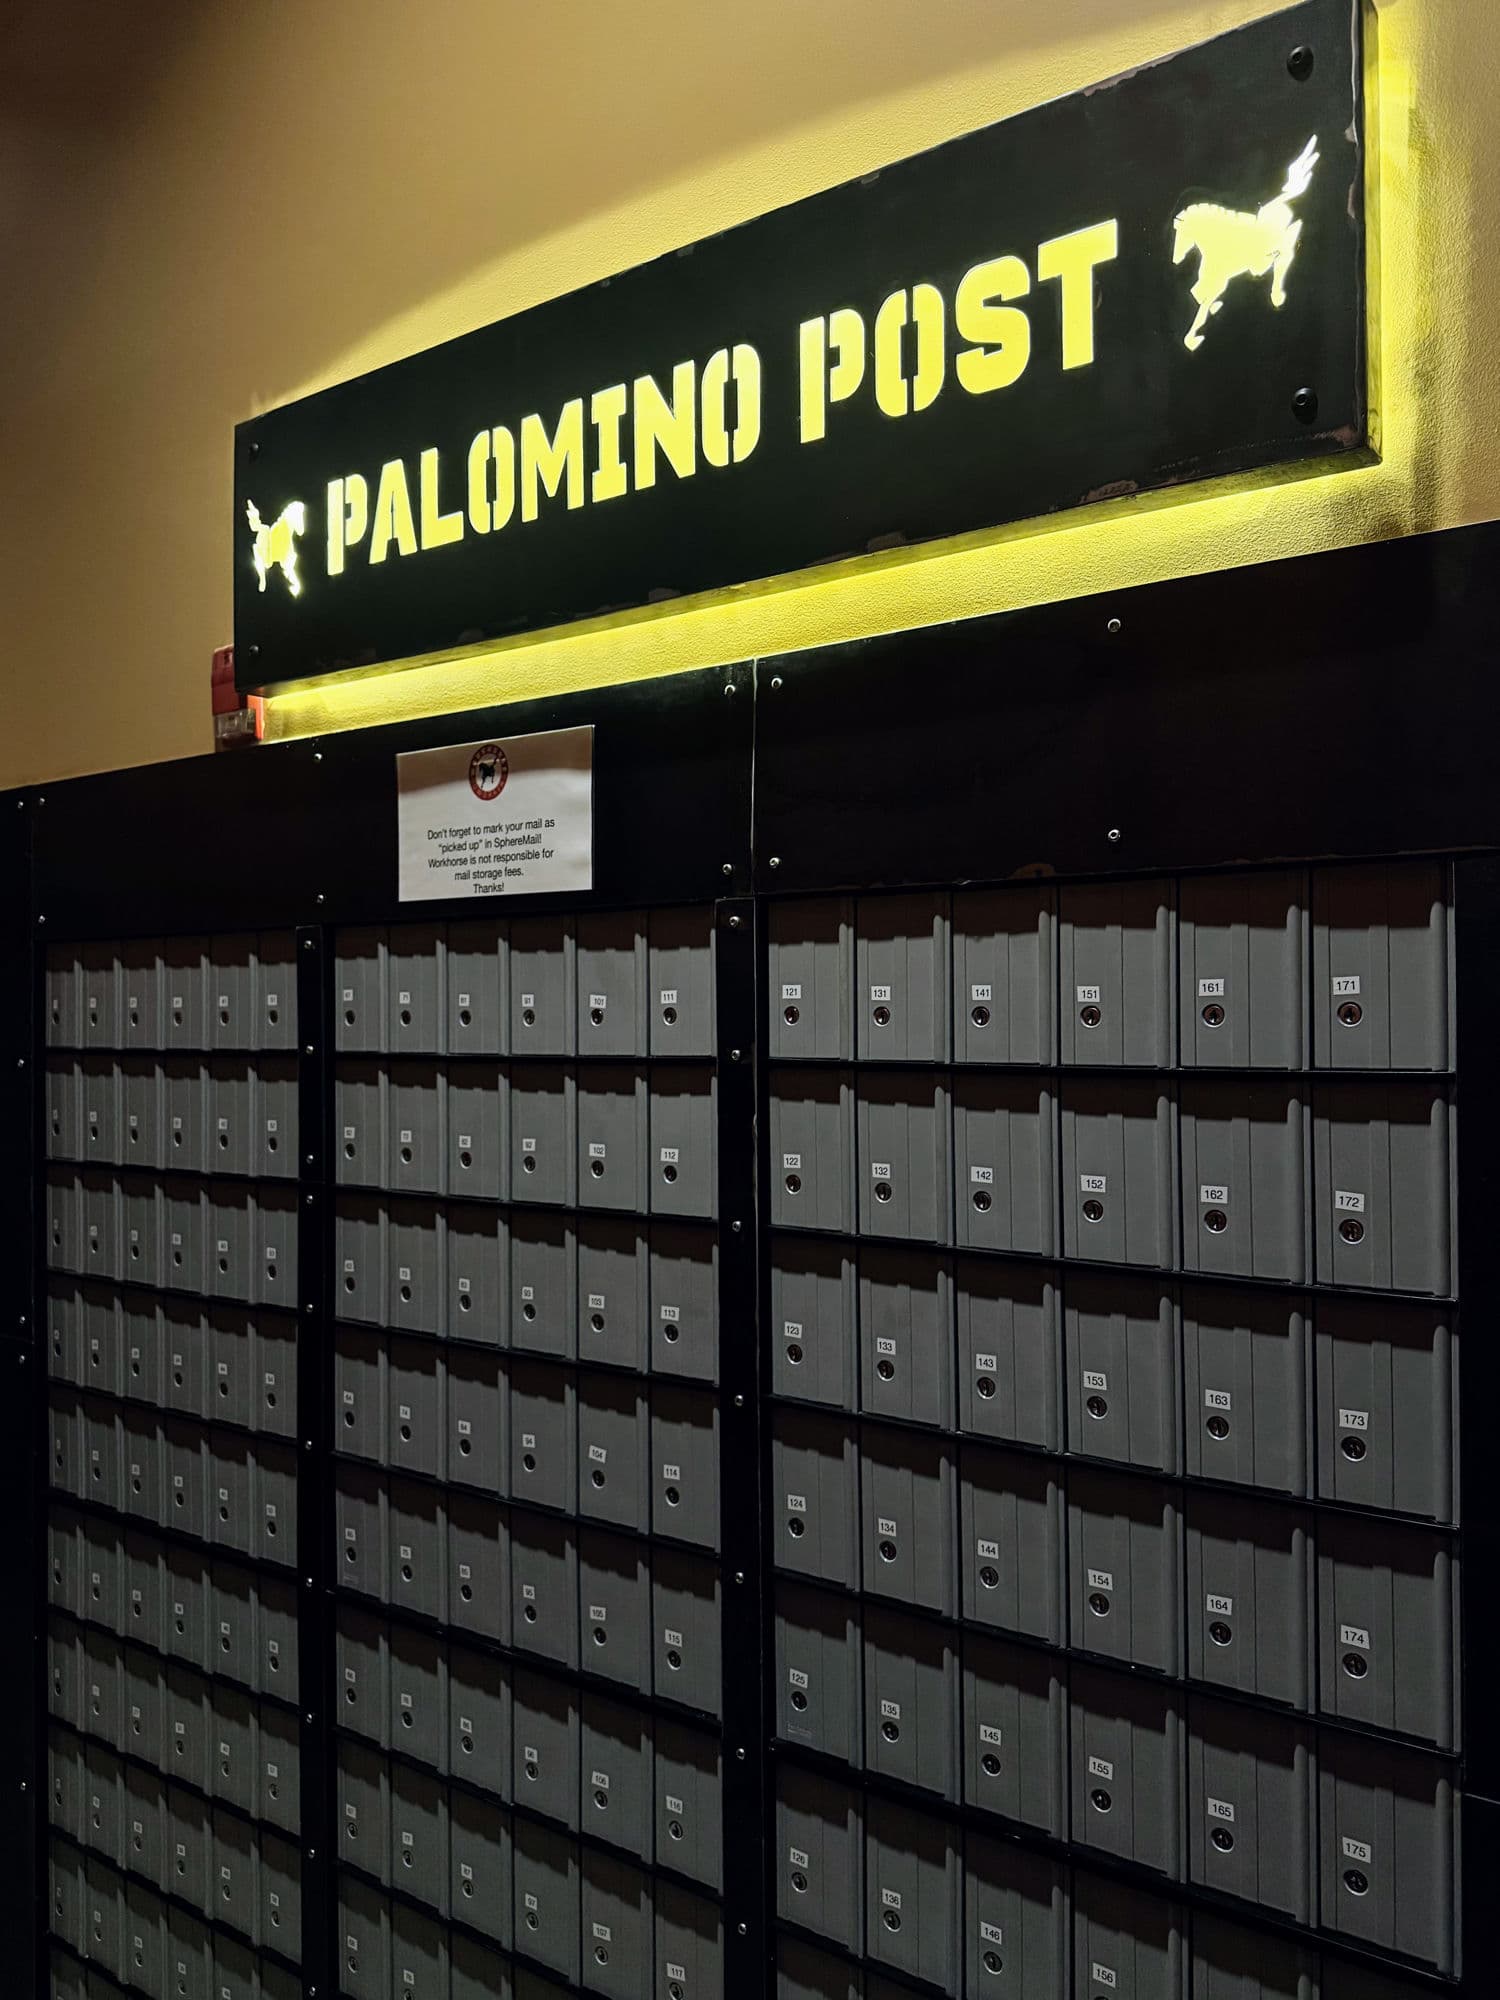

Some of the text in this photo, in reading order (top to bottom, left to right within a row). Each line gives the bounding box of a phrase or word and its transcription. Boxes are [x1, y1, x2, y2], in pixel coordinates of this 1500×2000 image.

[326, 218, 1118, 576] PALOMINO POST
[428, 818, 555, 840] Don't forget to mark your mail as
[484, 839, 492, 848] in
[494, 834, 542, 849] SphereMail!
[428, 848, 554, 868] Workhorse is not responsible for
[455, 867, 524, 880] mail storage fees.
[473, 882, 504, 894] Thanks!
[1202, 982, 1219, 993] 161
[1336, 980, 1356, 991] 171
[663, 993, 674, 1001] 111
[785, 987, 798, 997] 121
[873, 989, 887, 998] 131
[975, 988, 990, 997] 141
[1082, 989, 1097, 999] 151
[594, 997, 605, 1006] 101
[593, 1146, 604, 1155] 102
[664, 1151, 676, 1160] 112
[785, 1156, 799, 1166] 122
[874, 1166, 888, 1176] 132
[976, 1170, 992, 1181] 142
[1086, 1178, 1103, 1190] 152
[1204, 1189, 1224, 1200] 162
[1339, 1195, 1360, 1208] 172
[591, 1297, 602, 1306] 103
[786, 1325, 800, 1336] 123
[878, 1341, 893, 1352] 133
[978, 1357, 994, 1368] 143
[1086, 1375, 1104, 1387] 153
[1209, 1394, 1228, 1406] 163
[1344, 1414, 1365, 1427] 173
[592, 1449, 603, 1459] 104
[666, 1467, 678, 1477] 114
[790, 1498, 803, 1508] 124
[880, 1522, 895, 1534] 134
[981, 1544, 996, 1556] 144
[1092, 1574, 1110, 1586] 154
[1210, 1598, 1228, 1611] 164
[668, 1633, 680, 1645] 115
[1344, 1630, 1365, 1644] 174
[792, 1672, 806, 1685] 125
[883, 1703, 898, 1716] 135
[983, 1729, 999, 1742] 145
[1092, 1761, 1110, 1775] 155
[1212, 1803, 1232, 1818] 165
[1346, 1842, 1366, 1858] 175
[885, 1893, 900, 1906] 136
[984, 1927, 1000, 1941] 146
[671, 1967, 683, 1978] 117
[1096, 1968, 1114, 1983] 156
